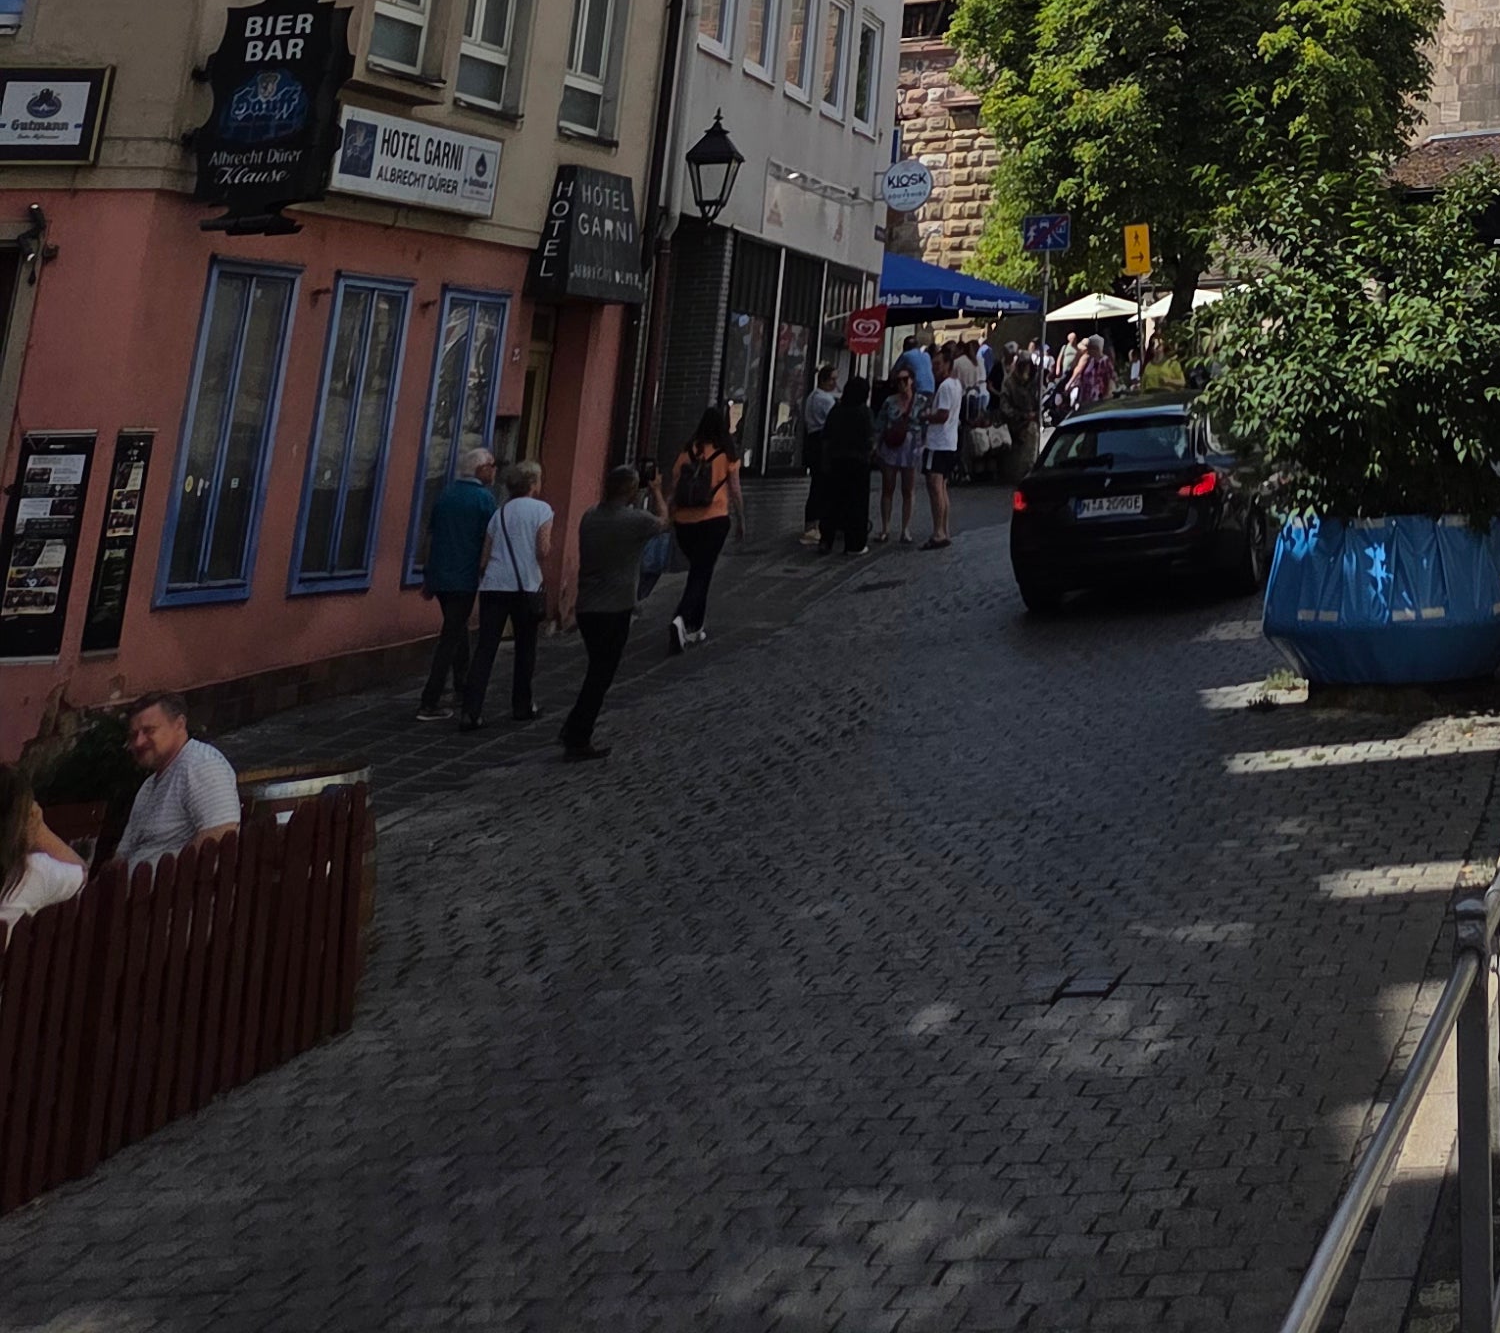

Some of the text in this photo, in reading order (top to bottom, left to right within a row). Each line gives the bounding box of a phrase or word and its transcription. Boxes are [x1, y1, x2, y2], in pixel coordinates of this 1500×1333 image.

[244, 12, 314, 38] BIER
[244, 38, 305, 62] BAR
[207, 148, 303, 167] Albrecht Dürer
[380, 127, 465, 171] HOTEL GARNI
[214, 166, 290, 184] Klause
[376, 165, 427, 190] ALBRECHT
[427, 172, 459, 196] DÜRER
[887, 171, 927, 189] KIOSK
[581, 184, 630, 212] HOTEL
[540, 180, 574, 277] HOTEL
[578, 212, 633, 244] GARNI
